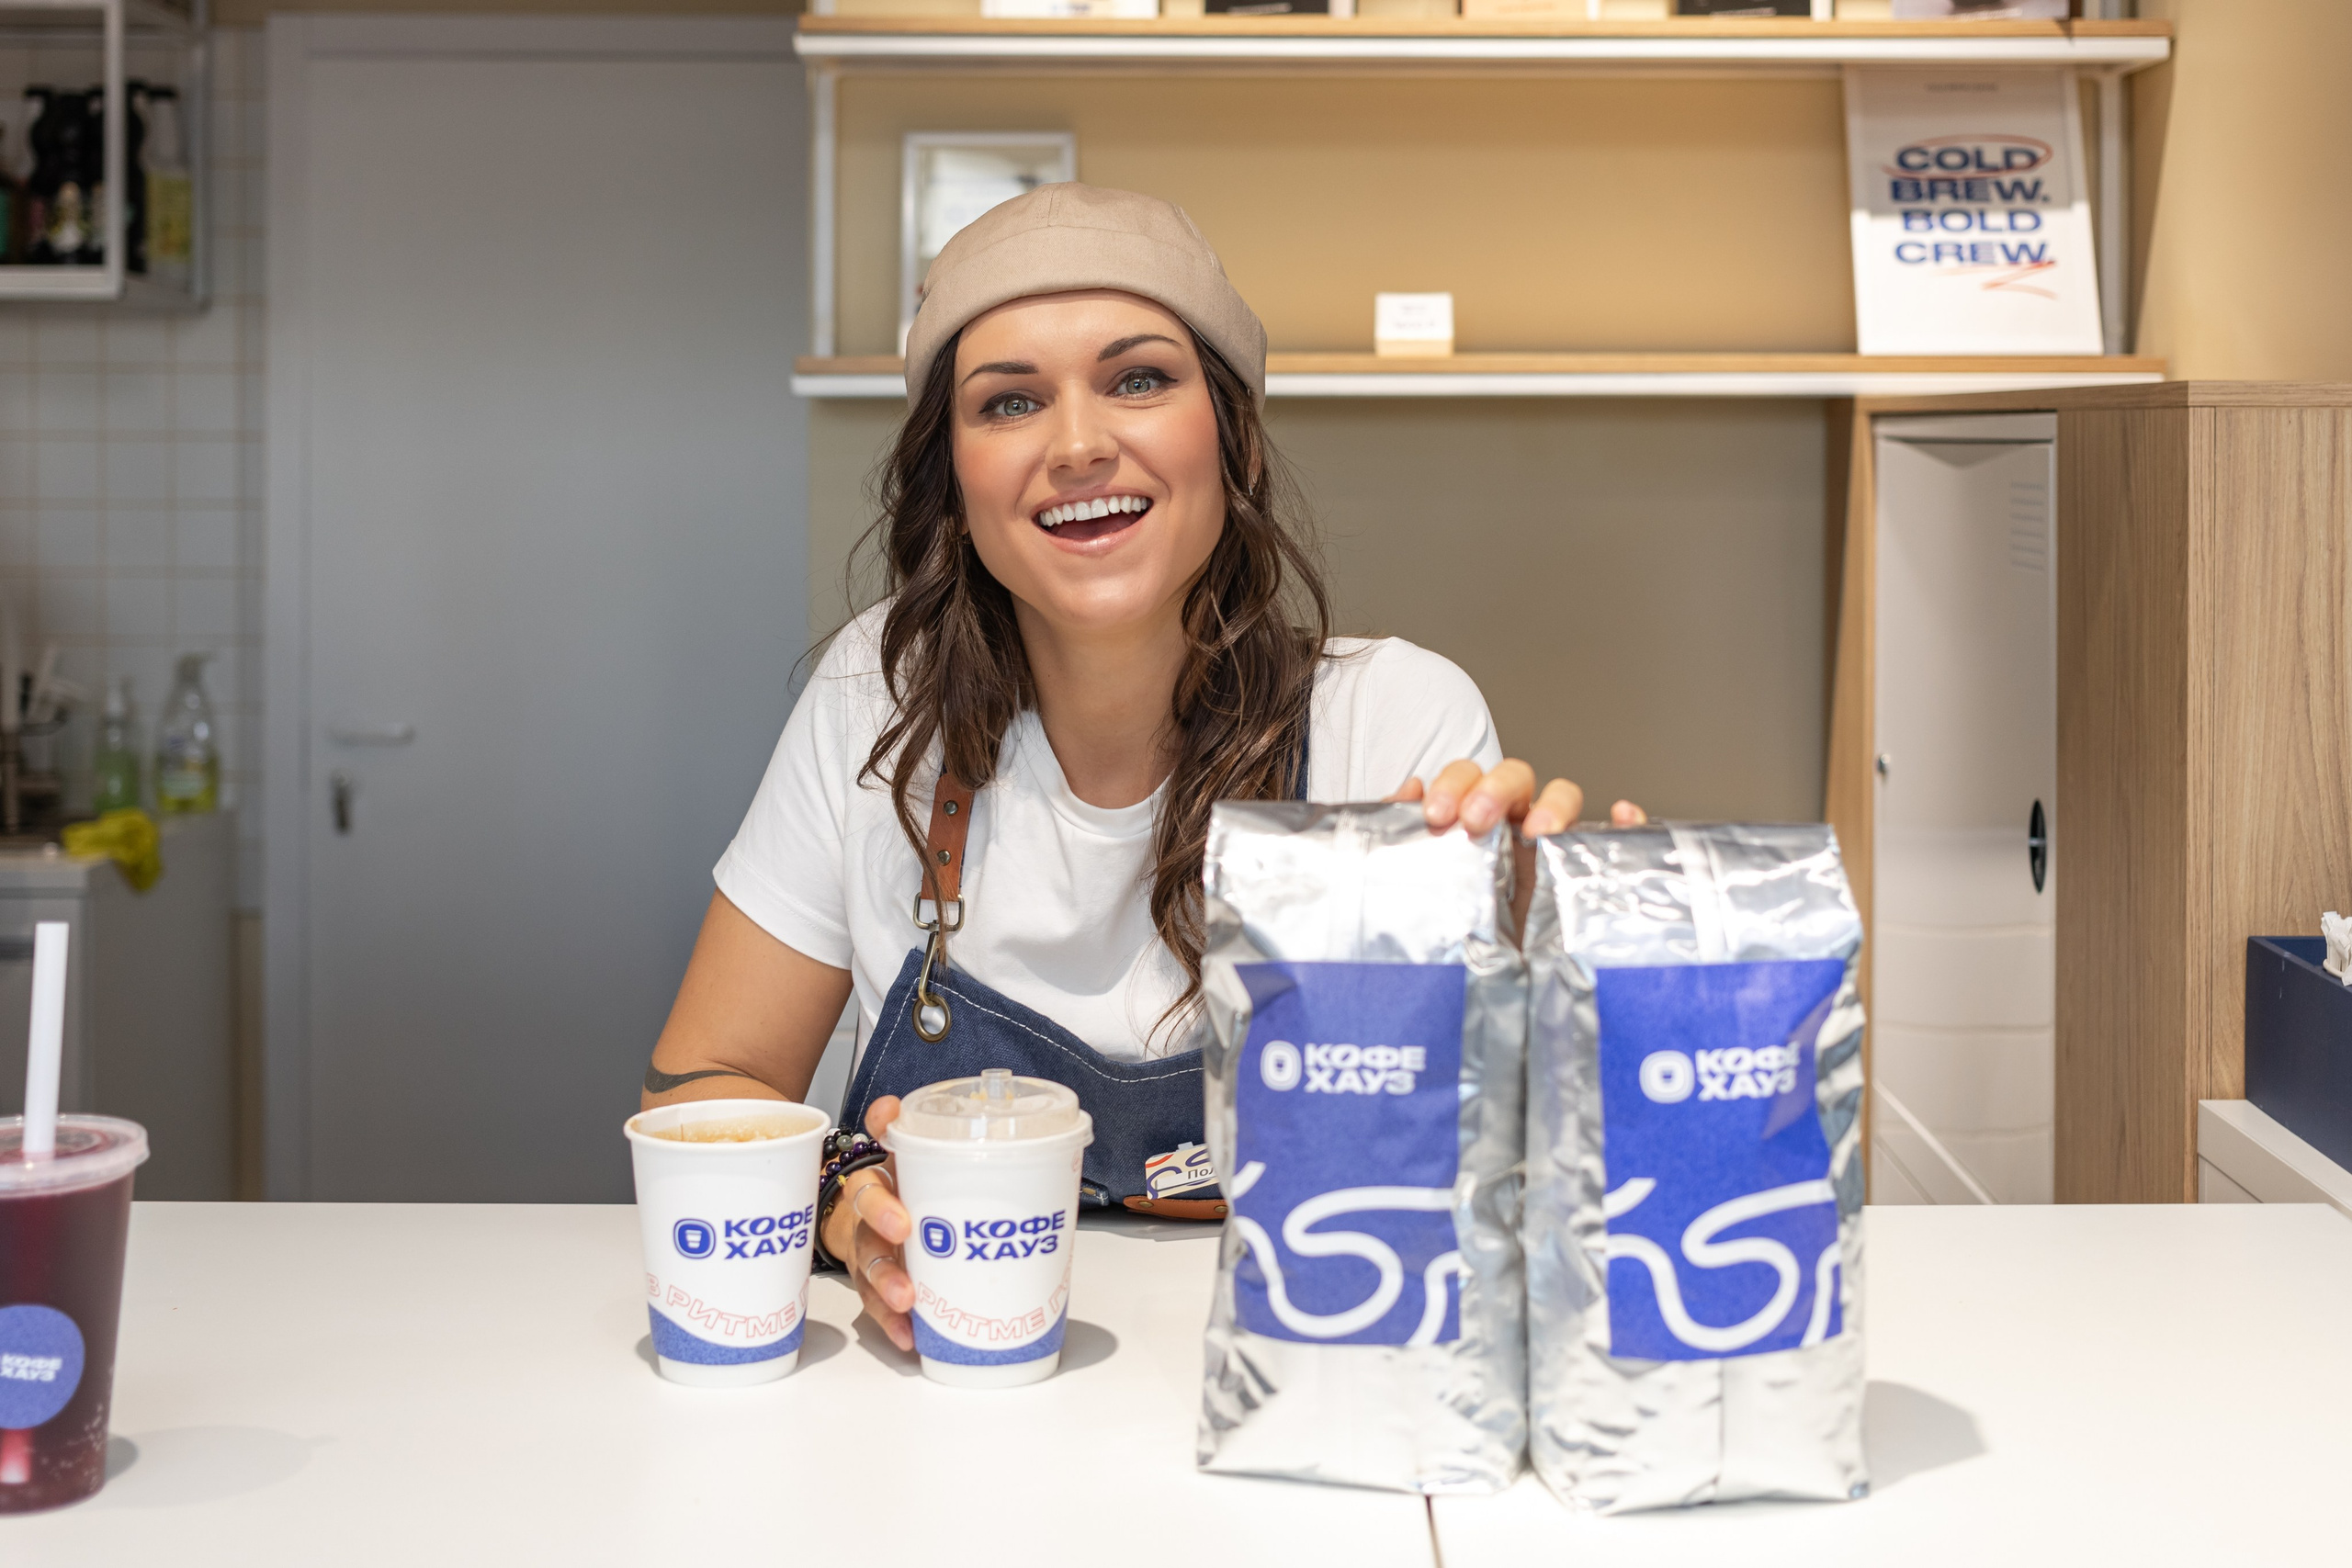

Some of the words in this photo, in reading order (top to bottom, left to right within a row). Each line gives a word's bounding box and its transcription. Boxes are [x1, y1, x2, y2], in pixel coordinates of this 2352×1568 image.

[1895, 146, 2039, 172] COLD
[1890, 178, 2051, 203] BREW.
[1901, 209, 2043, 232] BOLD
[1304, 1043, 1426, 1072] КОФЕ
[1303, 1067, 1417, 1095] ХАУЗ
[1697, 1066, 1797, 1101] ХАУЗ
[724, 1203, 814, 1238] КОФЕ
[964, 1209, 1066, 1239] КОФЕ
[723, 1228, 808, 1260] ХАУЗ
[965, 1234, 1058, 1260] ХАУЗ
[666, 1284, 797, 1338] РИТМЕ
[918, 1281, 1046, 1341] РИТМЕ
